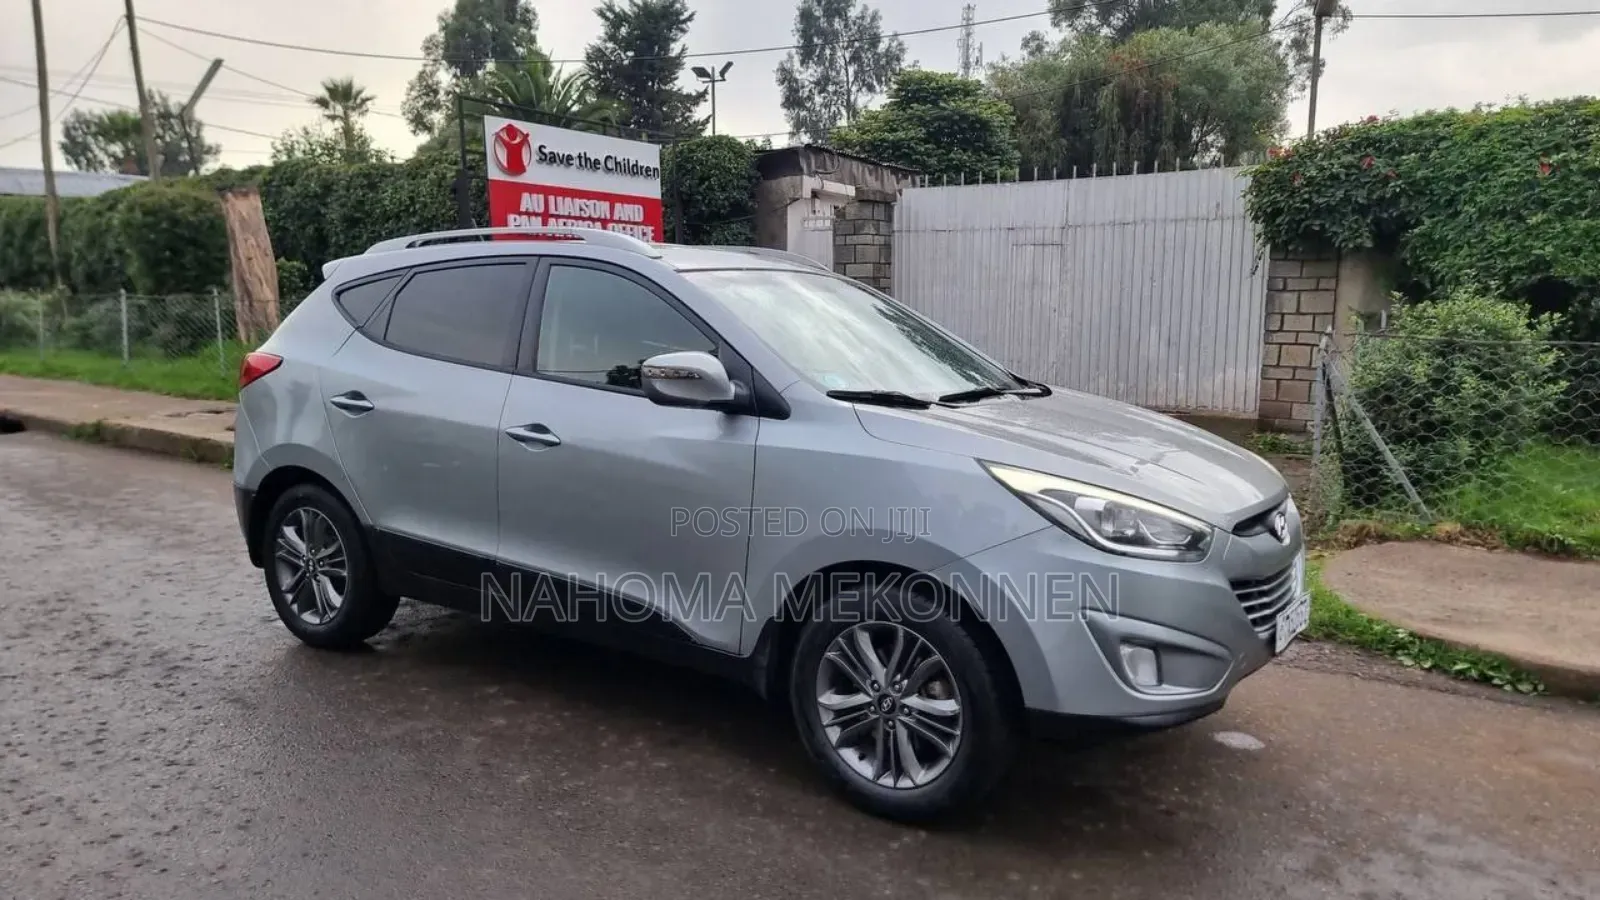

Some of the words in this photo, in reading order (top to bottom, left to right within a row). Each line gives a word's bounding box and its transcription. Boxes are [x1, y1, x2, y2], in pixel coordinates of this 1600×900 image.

[537, 145, 574, 166] Save
[574, 151, 601, 171] the
[604, 155, 660, 181] Children
[520, 192, 544, 213] AU
[548, 195, 611, 220] LIAISON
[614, 202, 644, 223] AND
